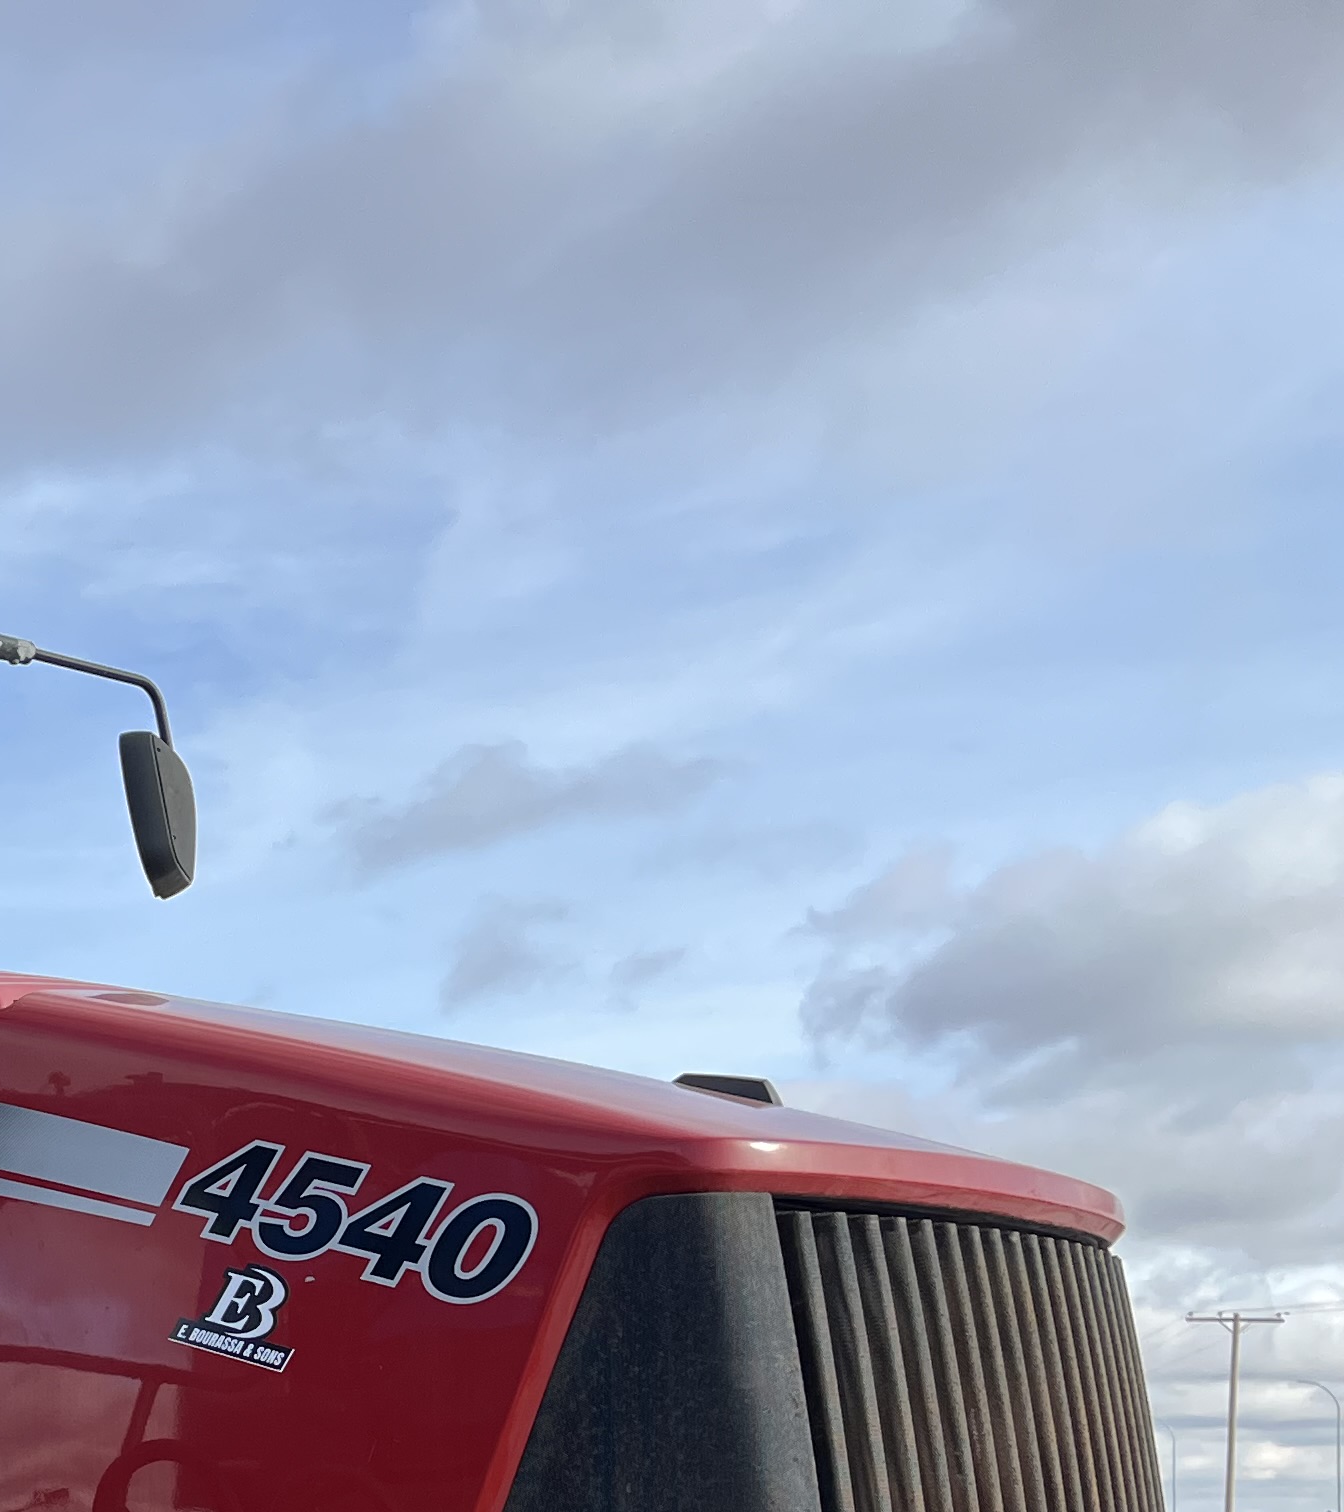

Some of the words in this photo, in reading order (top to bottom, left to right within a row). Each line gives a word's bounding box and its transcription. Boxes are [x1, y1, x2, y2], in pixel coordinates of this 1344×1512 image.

[171, 1138, 540, 1305] 4540
[189, 1328, 243, 1355] BOURASSA
[242, 1343, 255, 1358] &
[254, 1347, 285, 1366] SONS
